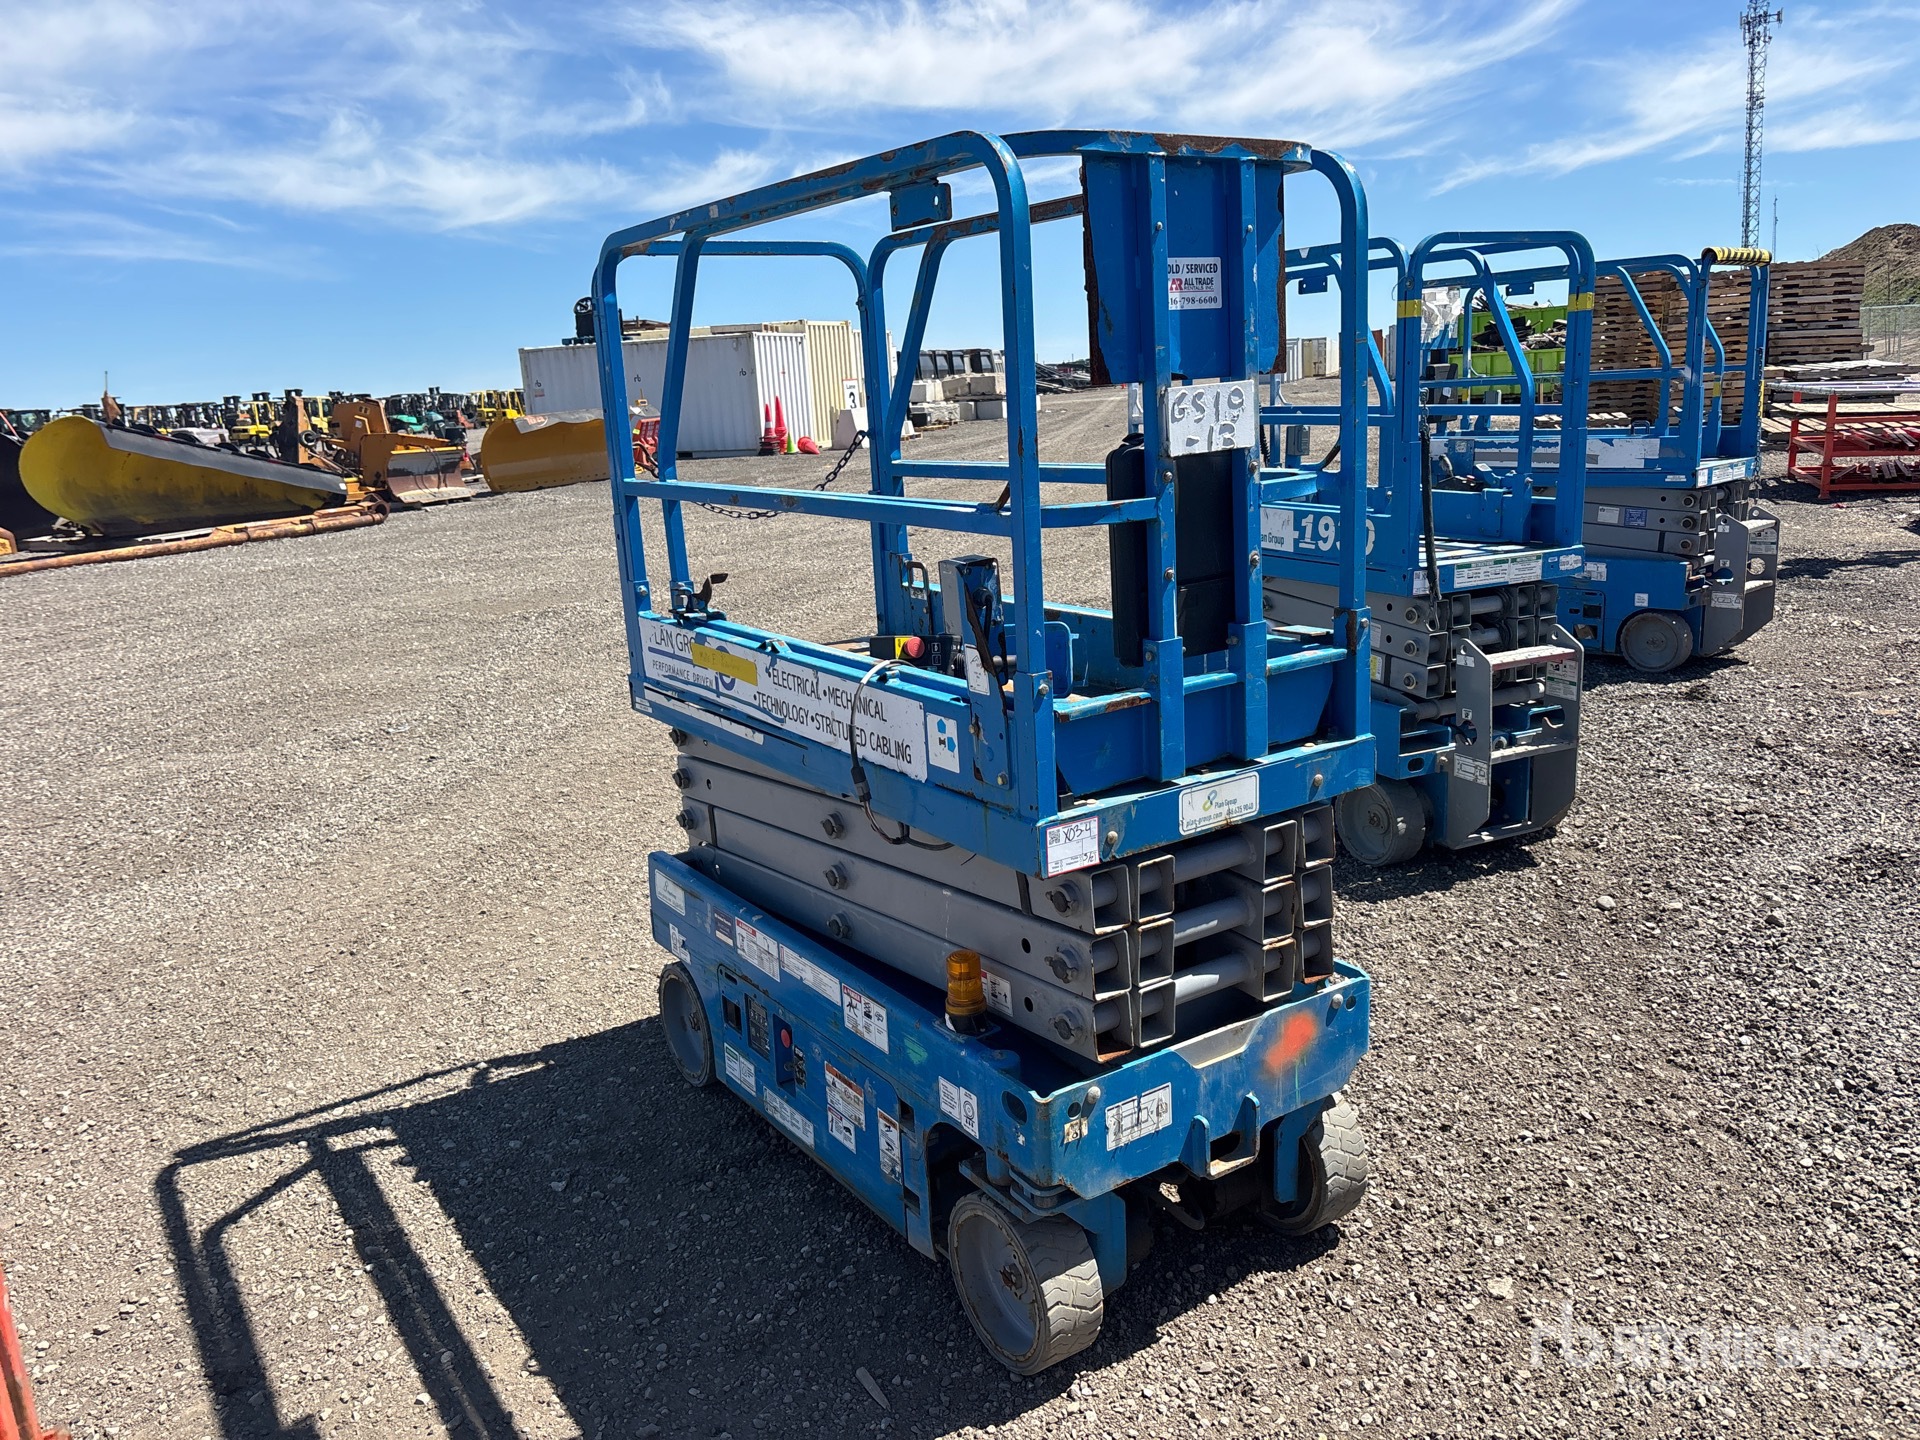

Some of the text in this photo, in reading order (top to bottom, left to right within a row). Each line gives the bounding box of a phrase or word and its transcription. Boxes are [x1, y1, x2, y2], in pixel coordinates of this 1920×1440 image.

[1185, 262, 1218, 274] SERVICED
[1184, 277, 1194, 286] ALL
[1195, 276, 1215, 286] TRADE
[1168, 295, 1218, 306] 16-798-6600
[849, 391, 857, 409] 3
[1267, 532, 1285, 548] Group
[650, 629, 675, 650] LAN
[652, 659, 691, 681] PERFORMANCE
[692, 672, 714, 688] DRIVEN
[772, 667, 822, 701] ELECTRICAL
[756, 690, 912, 764] TECHNOLOGY STRCTUED CABLING
[1214, 801, 1225, 809] Plan
